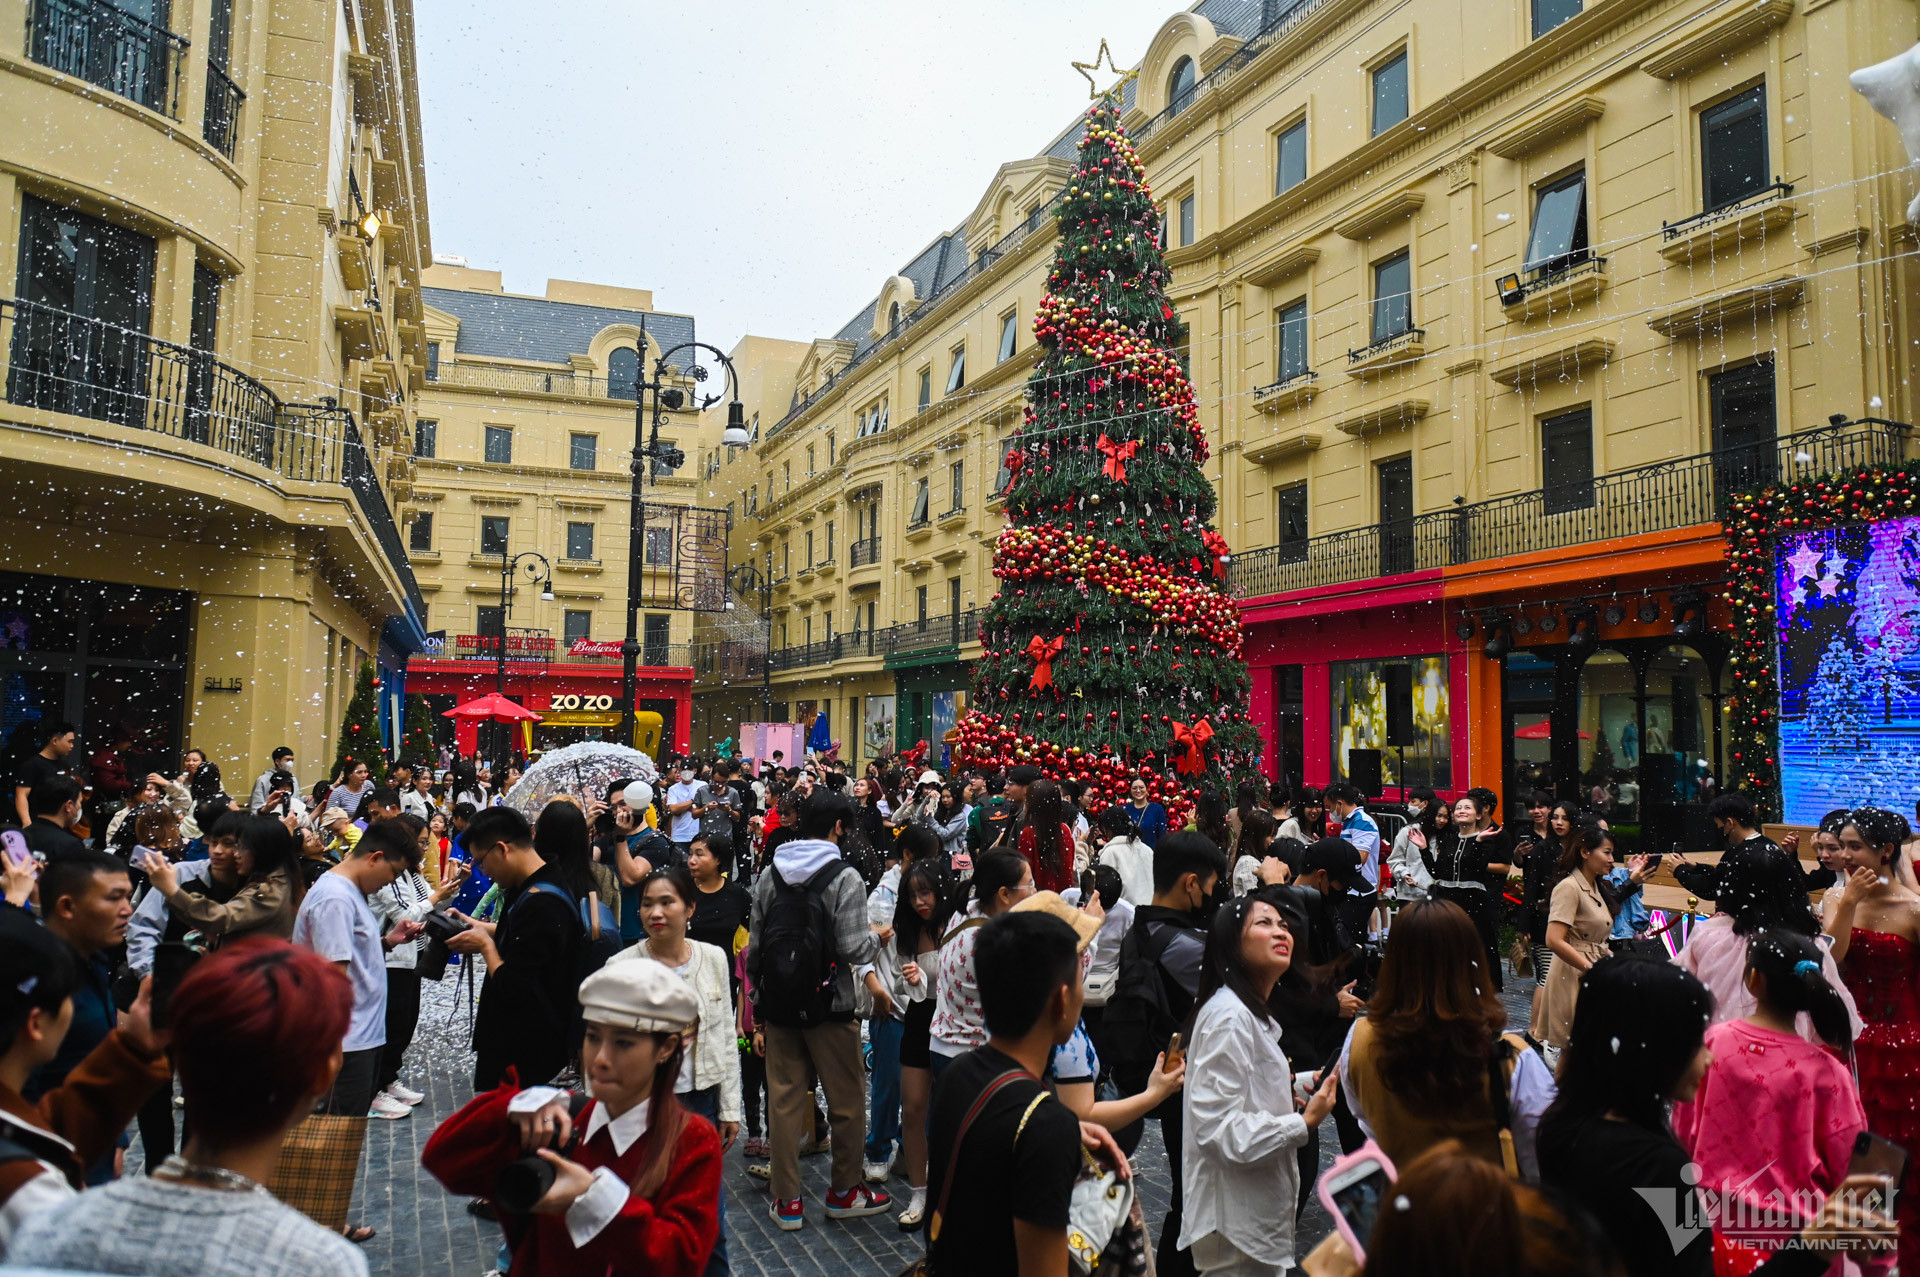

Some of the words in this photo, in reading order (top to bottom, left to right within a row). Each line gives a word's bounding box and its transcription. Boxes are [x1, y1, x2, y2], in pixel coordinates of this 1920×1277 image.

[423, 637, 444, 647] ON
[457, 634, 489, 648] MOTO
[493, 636, 523, 650] BER
[527, 637, 556, 651] CLUB
[573, 641, 622, 652] Budweise
[204, 676, 222, 689] SH
[229, 677, 243, 689] 15
